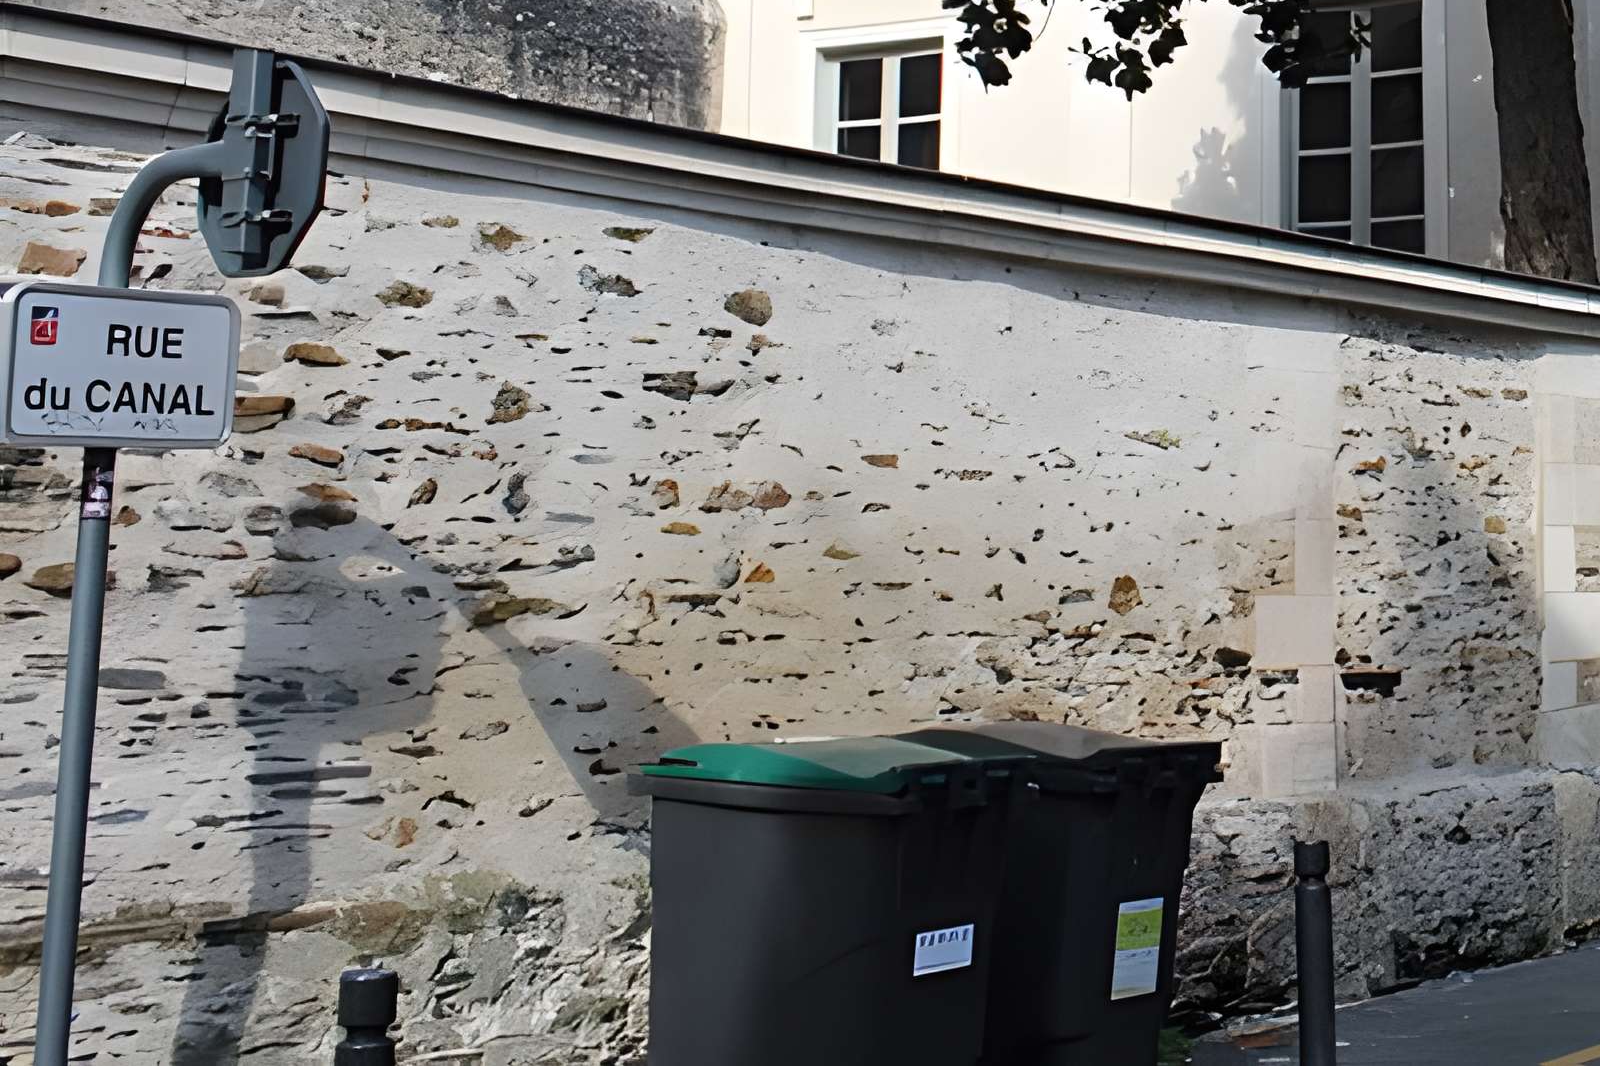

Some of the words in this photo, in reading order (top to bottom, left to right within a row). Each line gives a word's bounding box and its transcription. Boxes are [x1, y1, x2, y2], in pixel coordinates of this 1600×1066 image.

[107, 323, 184, 359] RUE
[24, 378, 71, 410] du
[85, 379, 215, 416] CANAL
